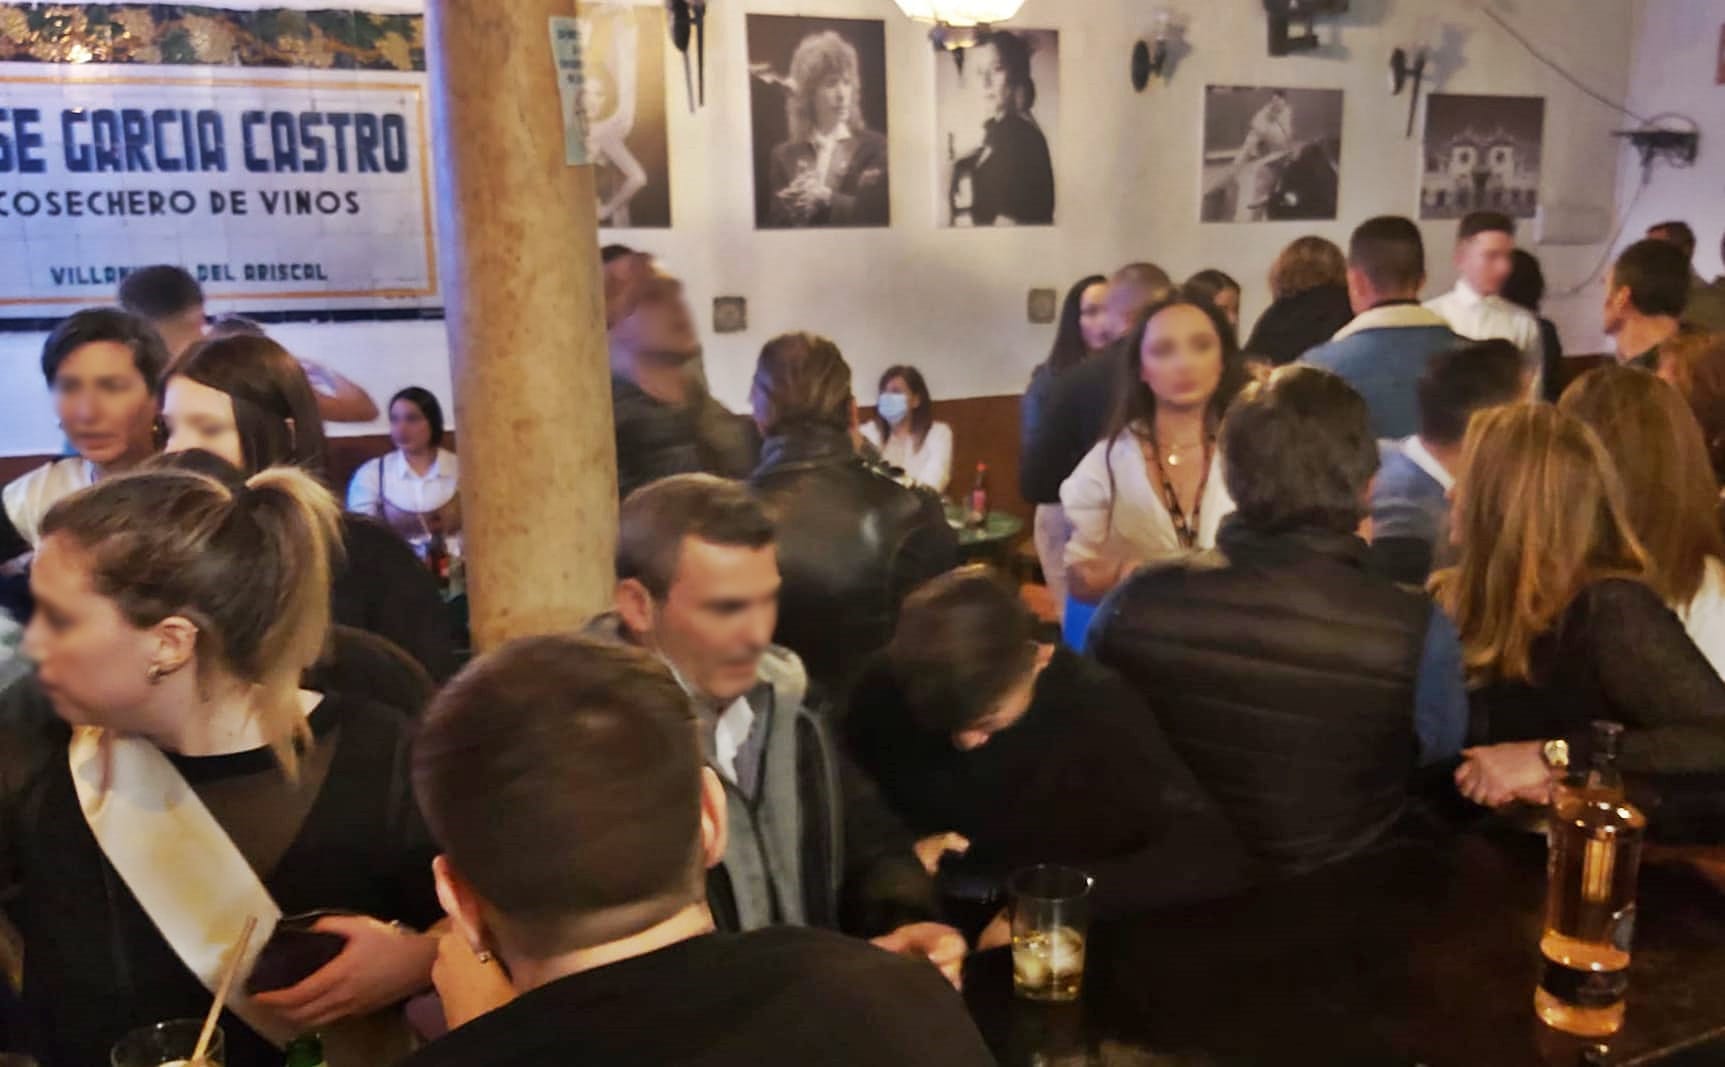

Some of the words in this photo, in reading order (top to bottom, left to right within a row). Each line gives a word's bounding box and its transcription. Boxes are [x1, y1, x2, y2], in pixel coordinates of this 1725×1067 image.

[61, 107, 228, 174] GARCIA
[241, 110, 409, 174] CASTRO
[210, 190, 248, 215] DE
[259, 190, 360, 216] VINOS
[50, 264, 136, 286] VILLA
[197, 263, 236, 283] DEL
[244, 263, 328, 282] ARISCAL
